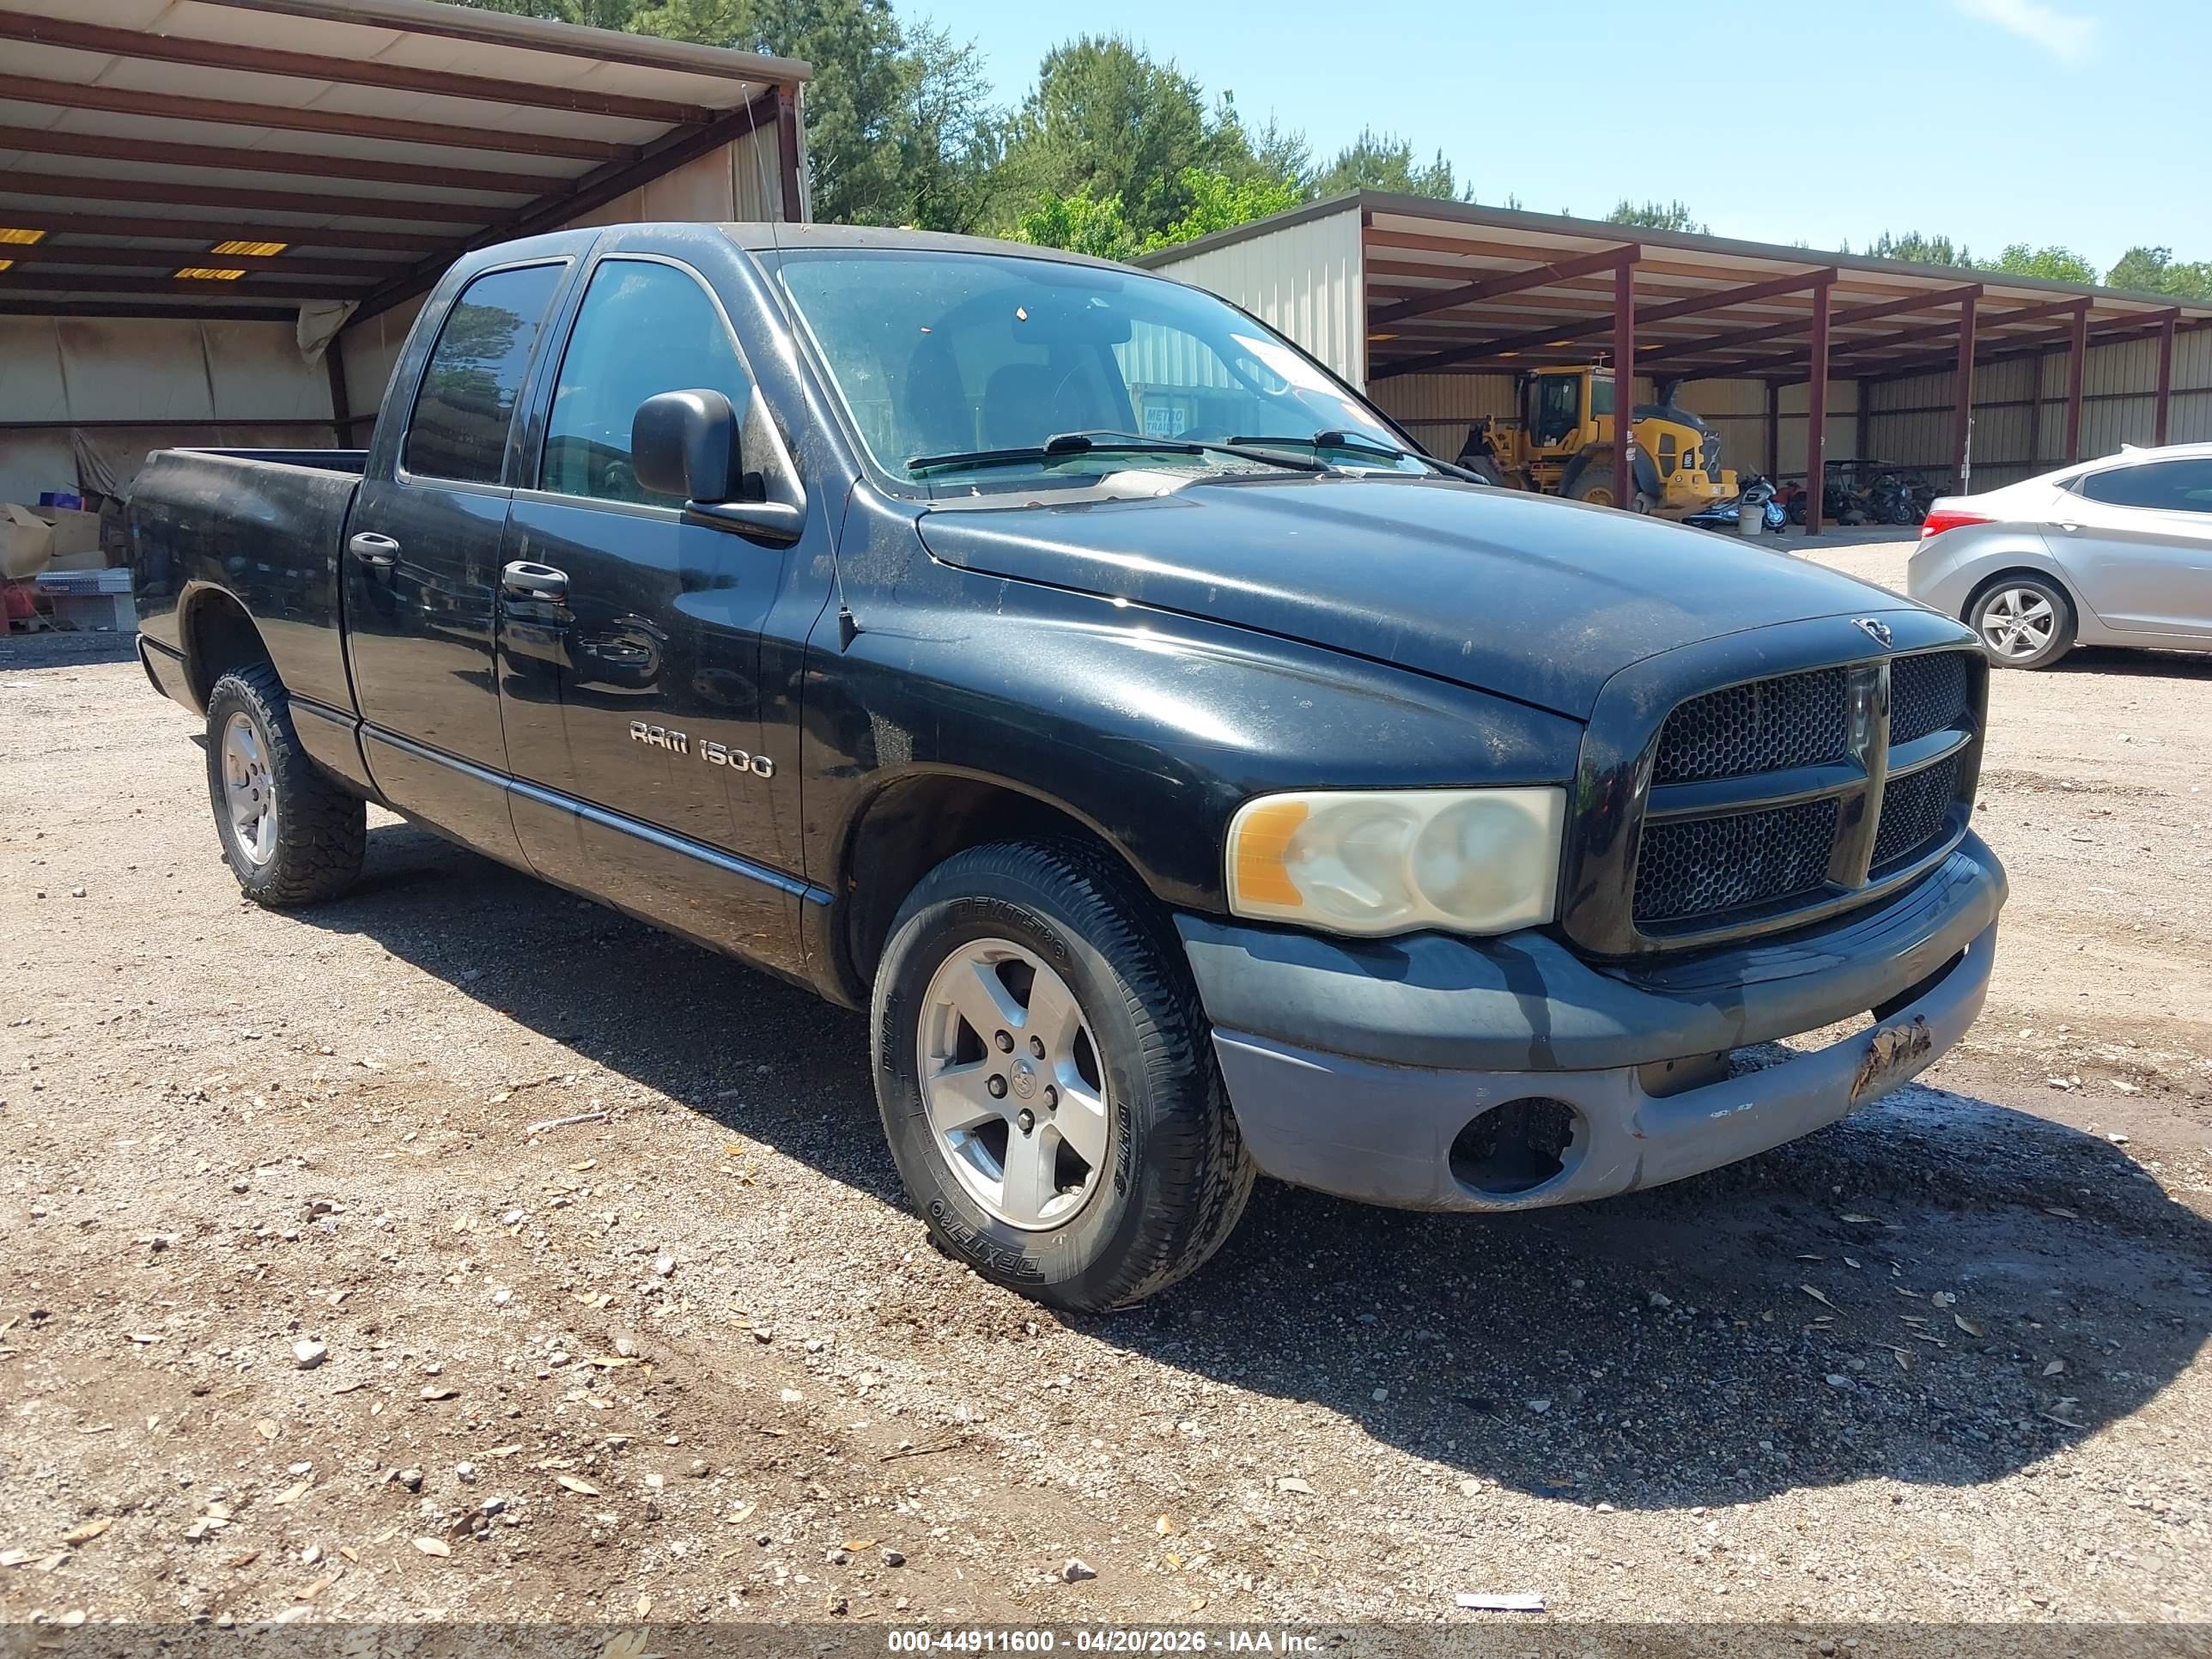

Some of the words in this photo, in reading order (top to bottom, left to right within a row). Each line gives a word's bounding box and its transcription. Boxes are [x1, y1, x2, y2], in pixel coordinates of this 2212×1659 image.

[629, 720, 689, 755] RAM
[699, 739, 775, 778] 1500
[931, 1198, 1045, 1279] DEXTERO
